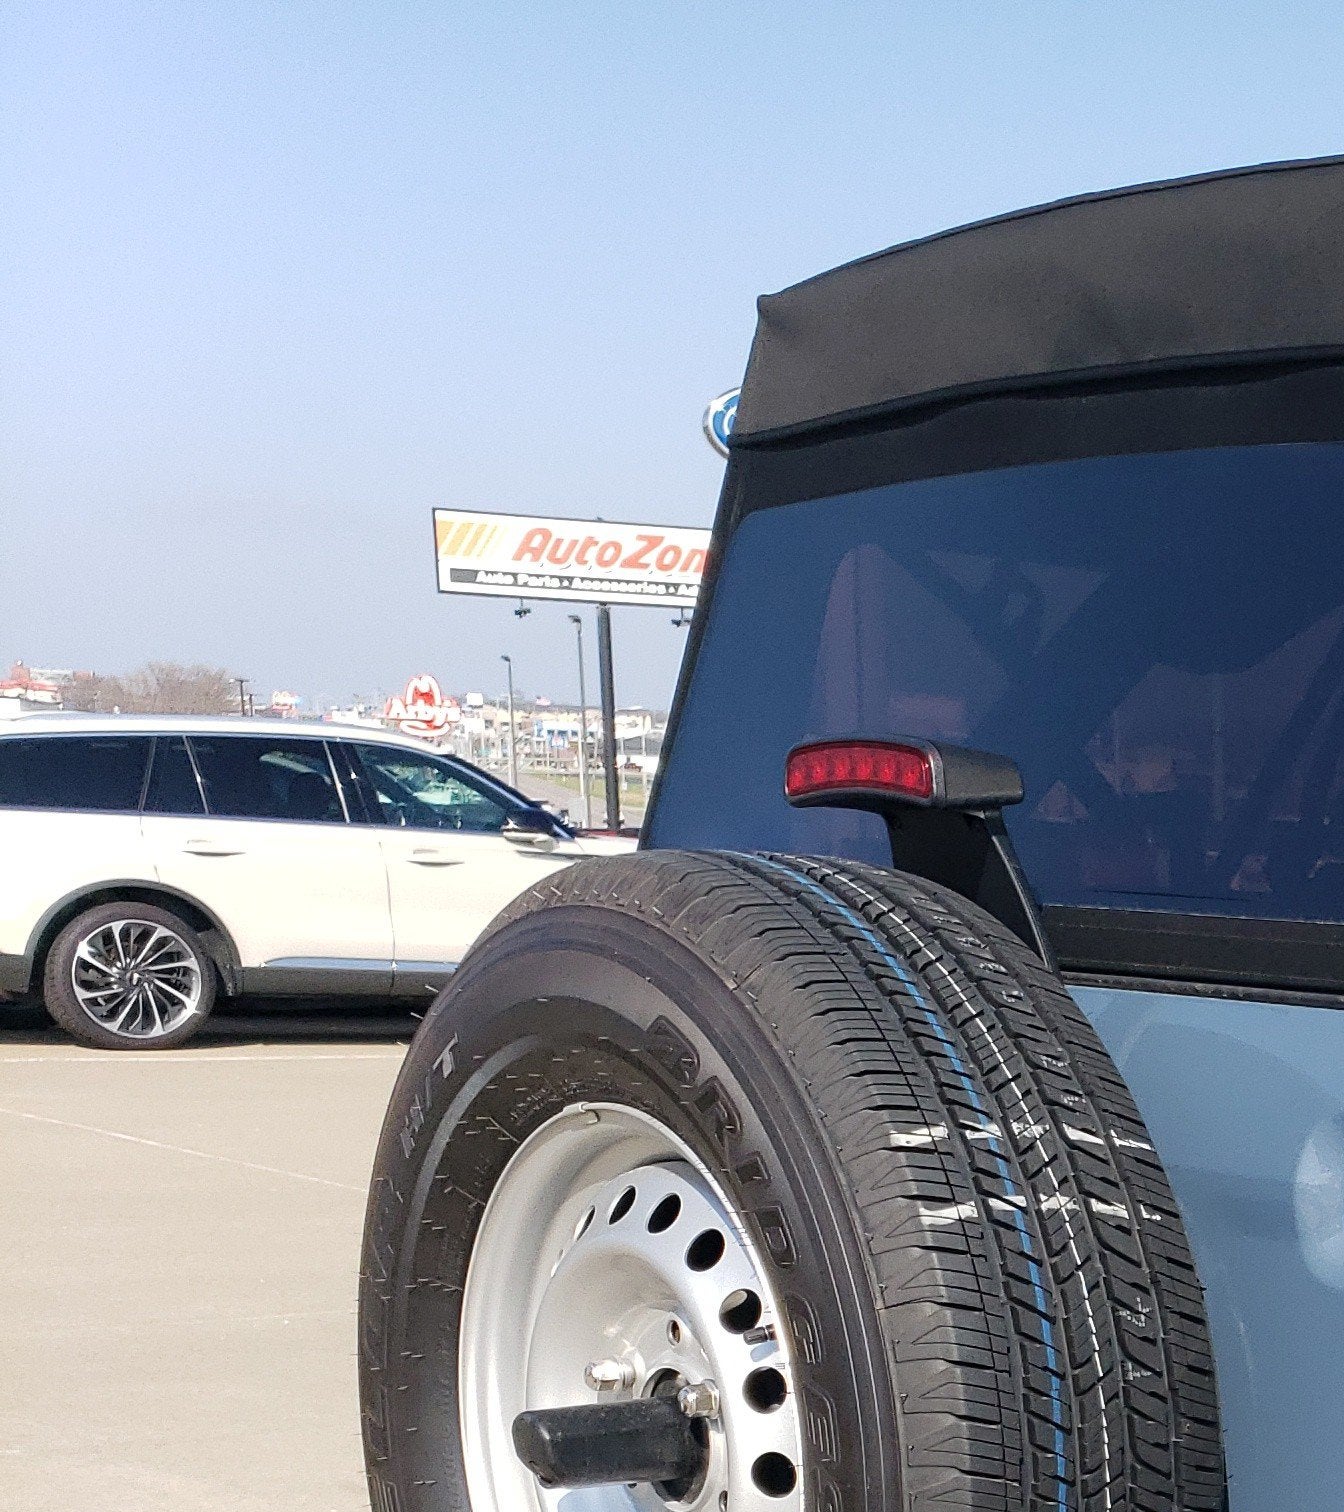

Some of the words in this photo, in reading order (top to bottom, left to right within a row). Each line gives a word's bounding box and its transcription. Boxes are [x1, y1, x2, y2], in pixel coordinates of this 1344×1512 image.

[511, 528, 707, 572] AutoZon
[475, 570, 515, 585] Auto
[517, 573, 561, 588] Parts
